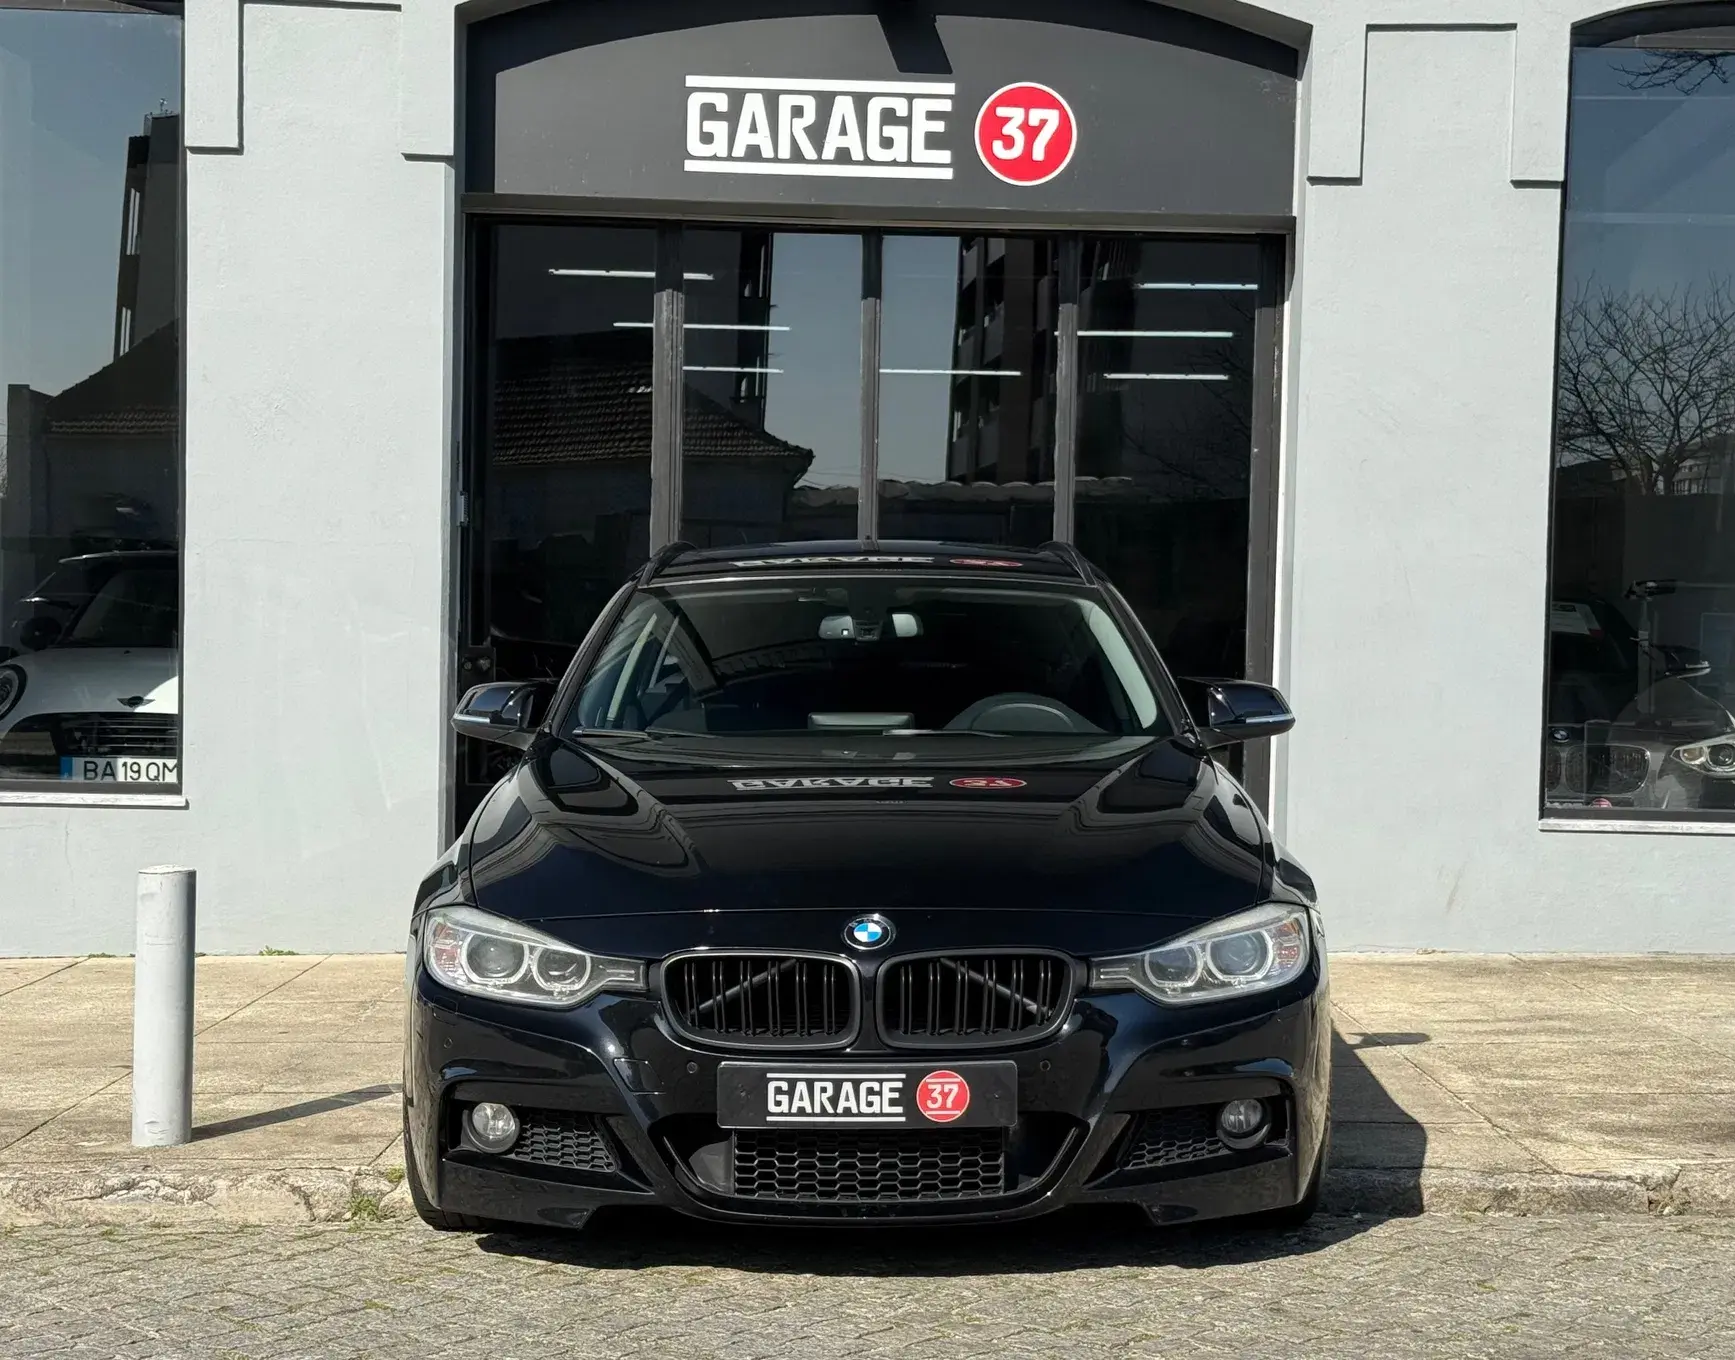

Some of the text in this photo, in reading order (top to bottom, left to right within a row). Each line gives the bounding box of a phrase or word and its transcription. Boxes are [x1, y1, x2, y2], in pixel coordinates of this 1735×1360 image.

[686, 91, 1060, 163] GARAGE 37
[83, 760, 117, 781] BA
[121, 761, 141, 781] 19
[766, 1081, 959, 1114] GARAGE 37
